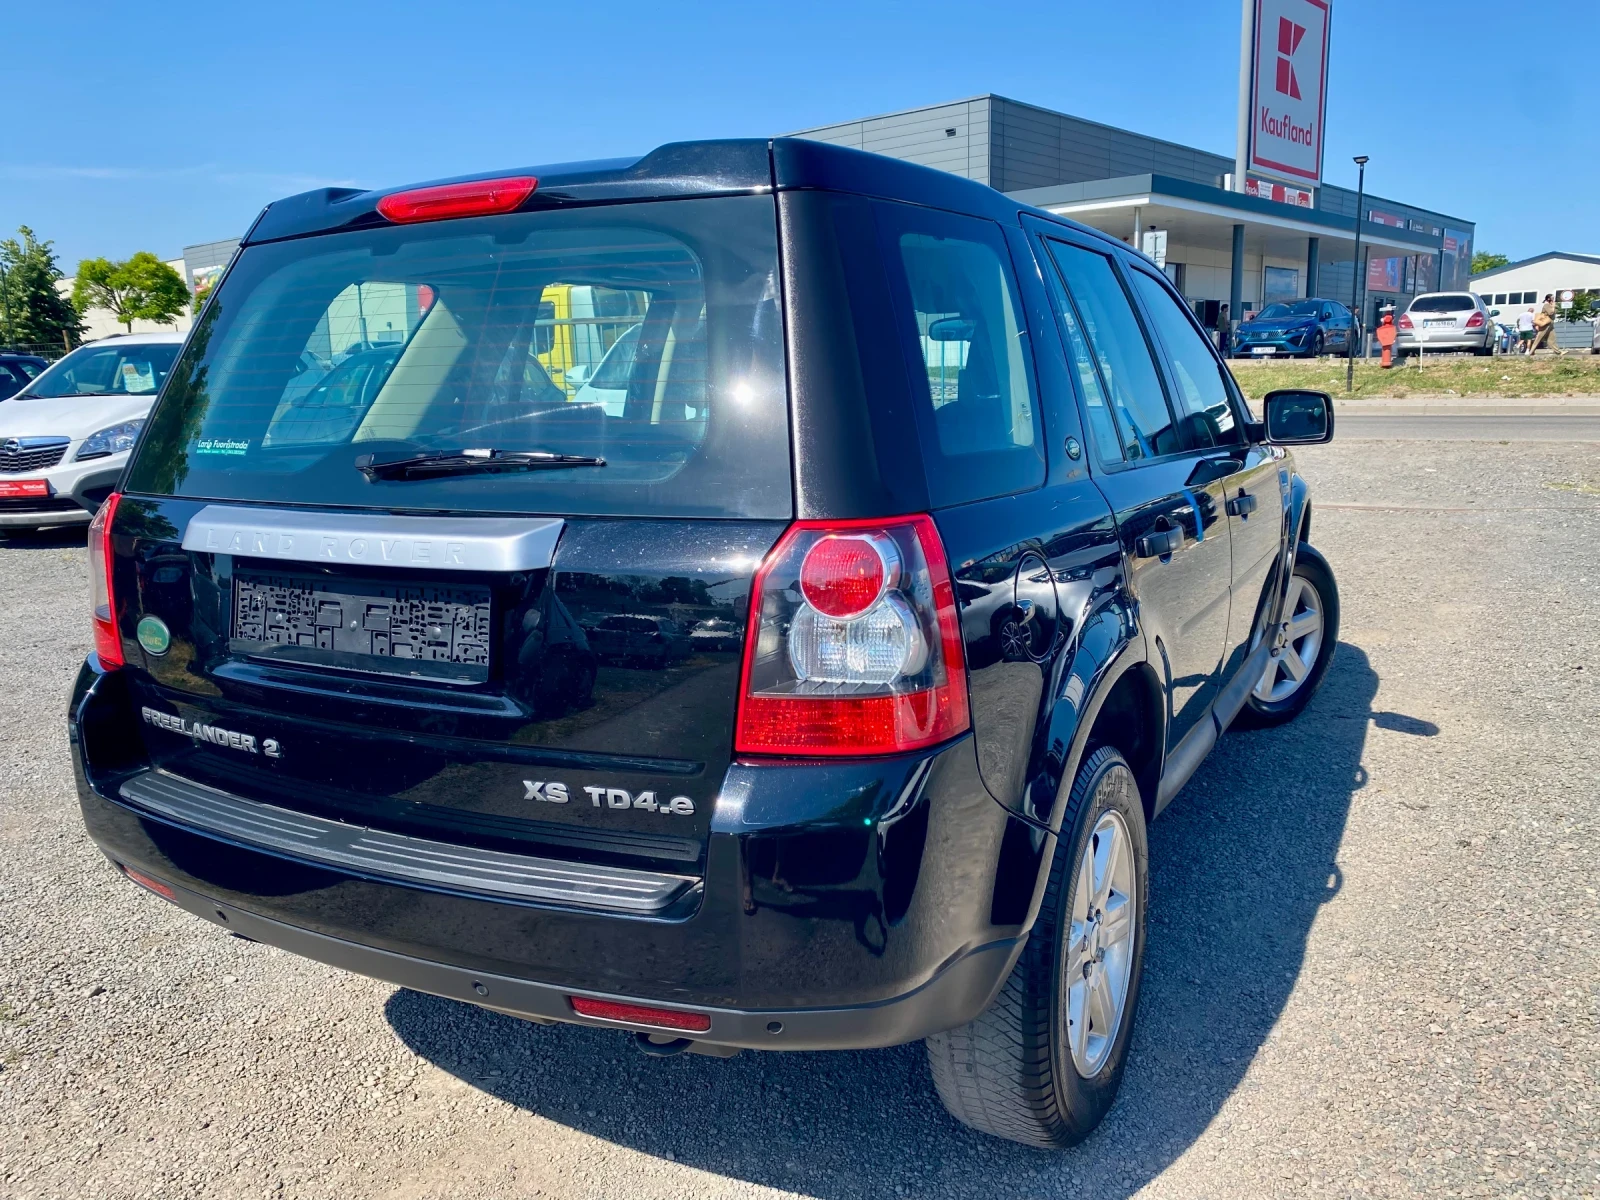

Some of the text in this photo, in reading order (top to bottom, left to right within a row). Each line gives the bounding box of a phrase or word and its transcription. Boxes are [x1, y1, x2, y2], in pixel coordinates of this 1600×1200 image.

[1262, 106, 1312, 146] Kaufland
[206, 528, 467, 565] LAND ROVER
[141, 706, 281, 758] FREELANDER 2
[523, 780, 696, 816] XS TD4.e
